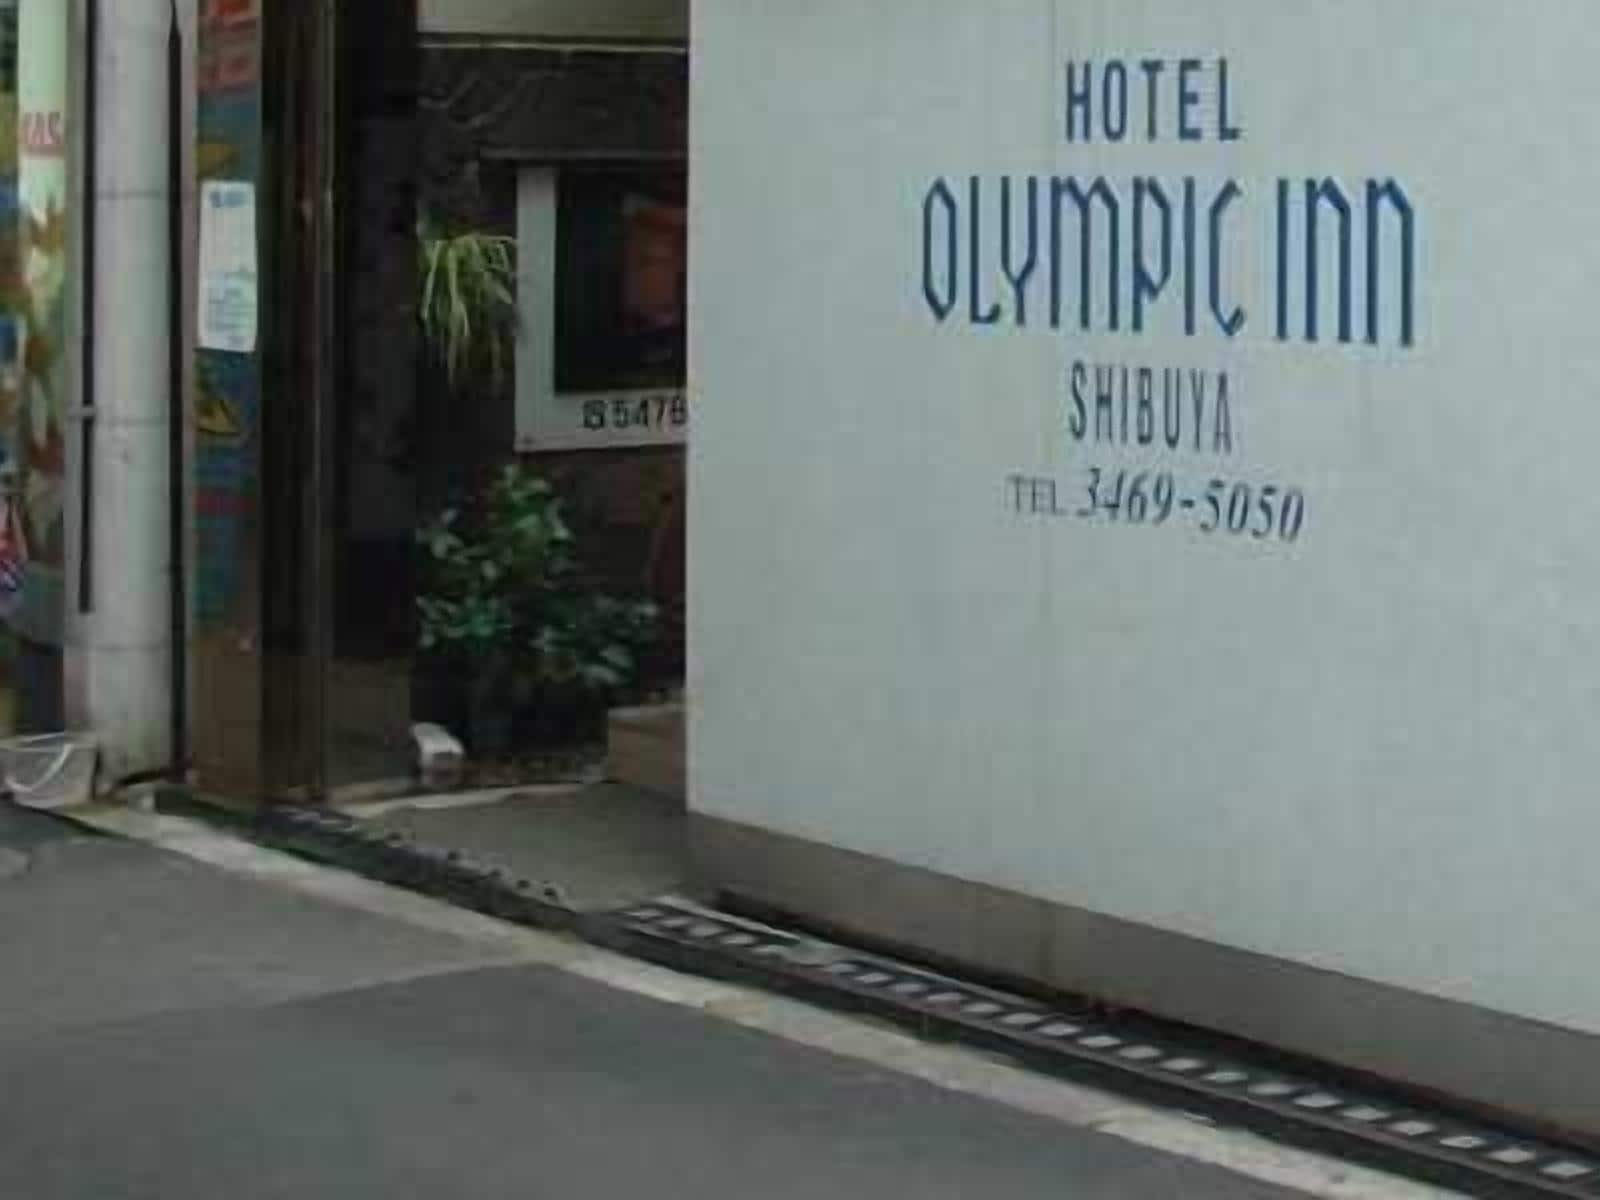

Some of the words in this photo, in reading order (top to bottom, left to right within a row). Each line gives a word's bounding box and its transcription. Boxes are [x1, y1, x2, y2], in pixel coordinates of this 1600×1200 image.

[1065, 58, 1242, 142] HOTEL
[921, 175, 1246, 338] OLYMPIC
[1276, 176, 1416, 349] INN
[1068, 361, 1233, 454] SHIBUYA
[1076, 466, 1304, 542] 3469-5050
